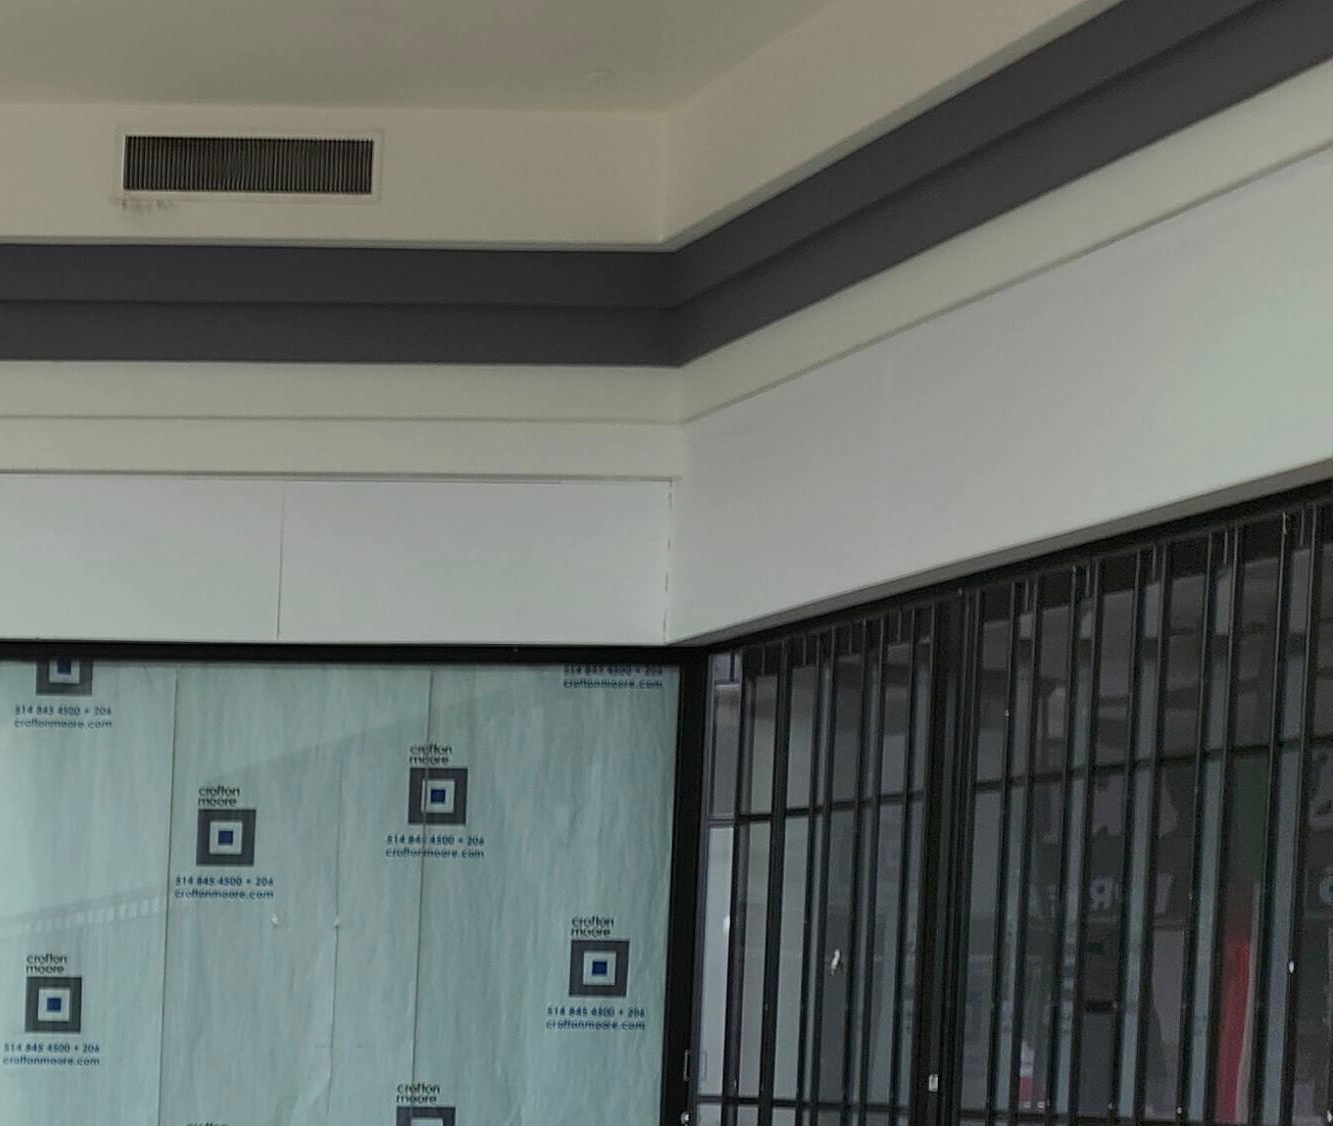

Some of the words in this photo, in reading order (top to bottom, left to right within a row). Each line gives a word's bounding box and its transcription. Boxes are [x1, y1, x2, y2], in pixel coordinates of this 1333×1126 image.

[410, 744, 452, 754] crofton
[409, 756, 449, 765] moore
[198, 786, 240, 797] crofton
[198, 798, 237, 806] moore
[572, 916, 614, 928] crofton
[571, 929, 611, 937] moore
[26, 953, 67, 964] crofton
[26, 965, 64, 974] moore
[397, 1083, 440, 1094] crofton
[396, 1095, 437, 1104] moore
